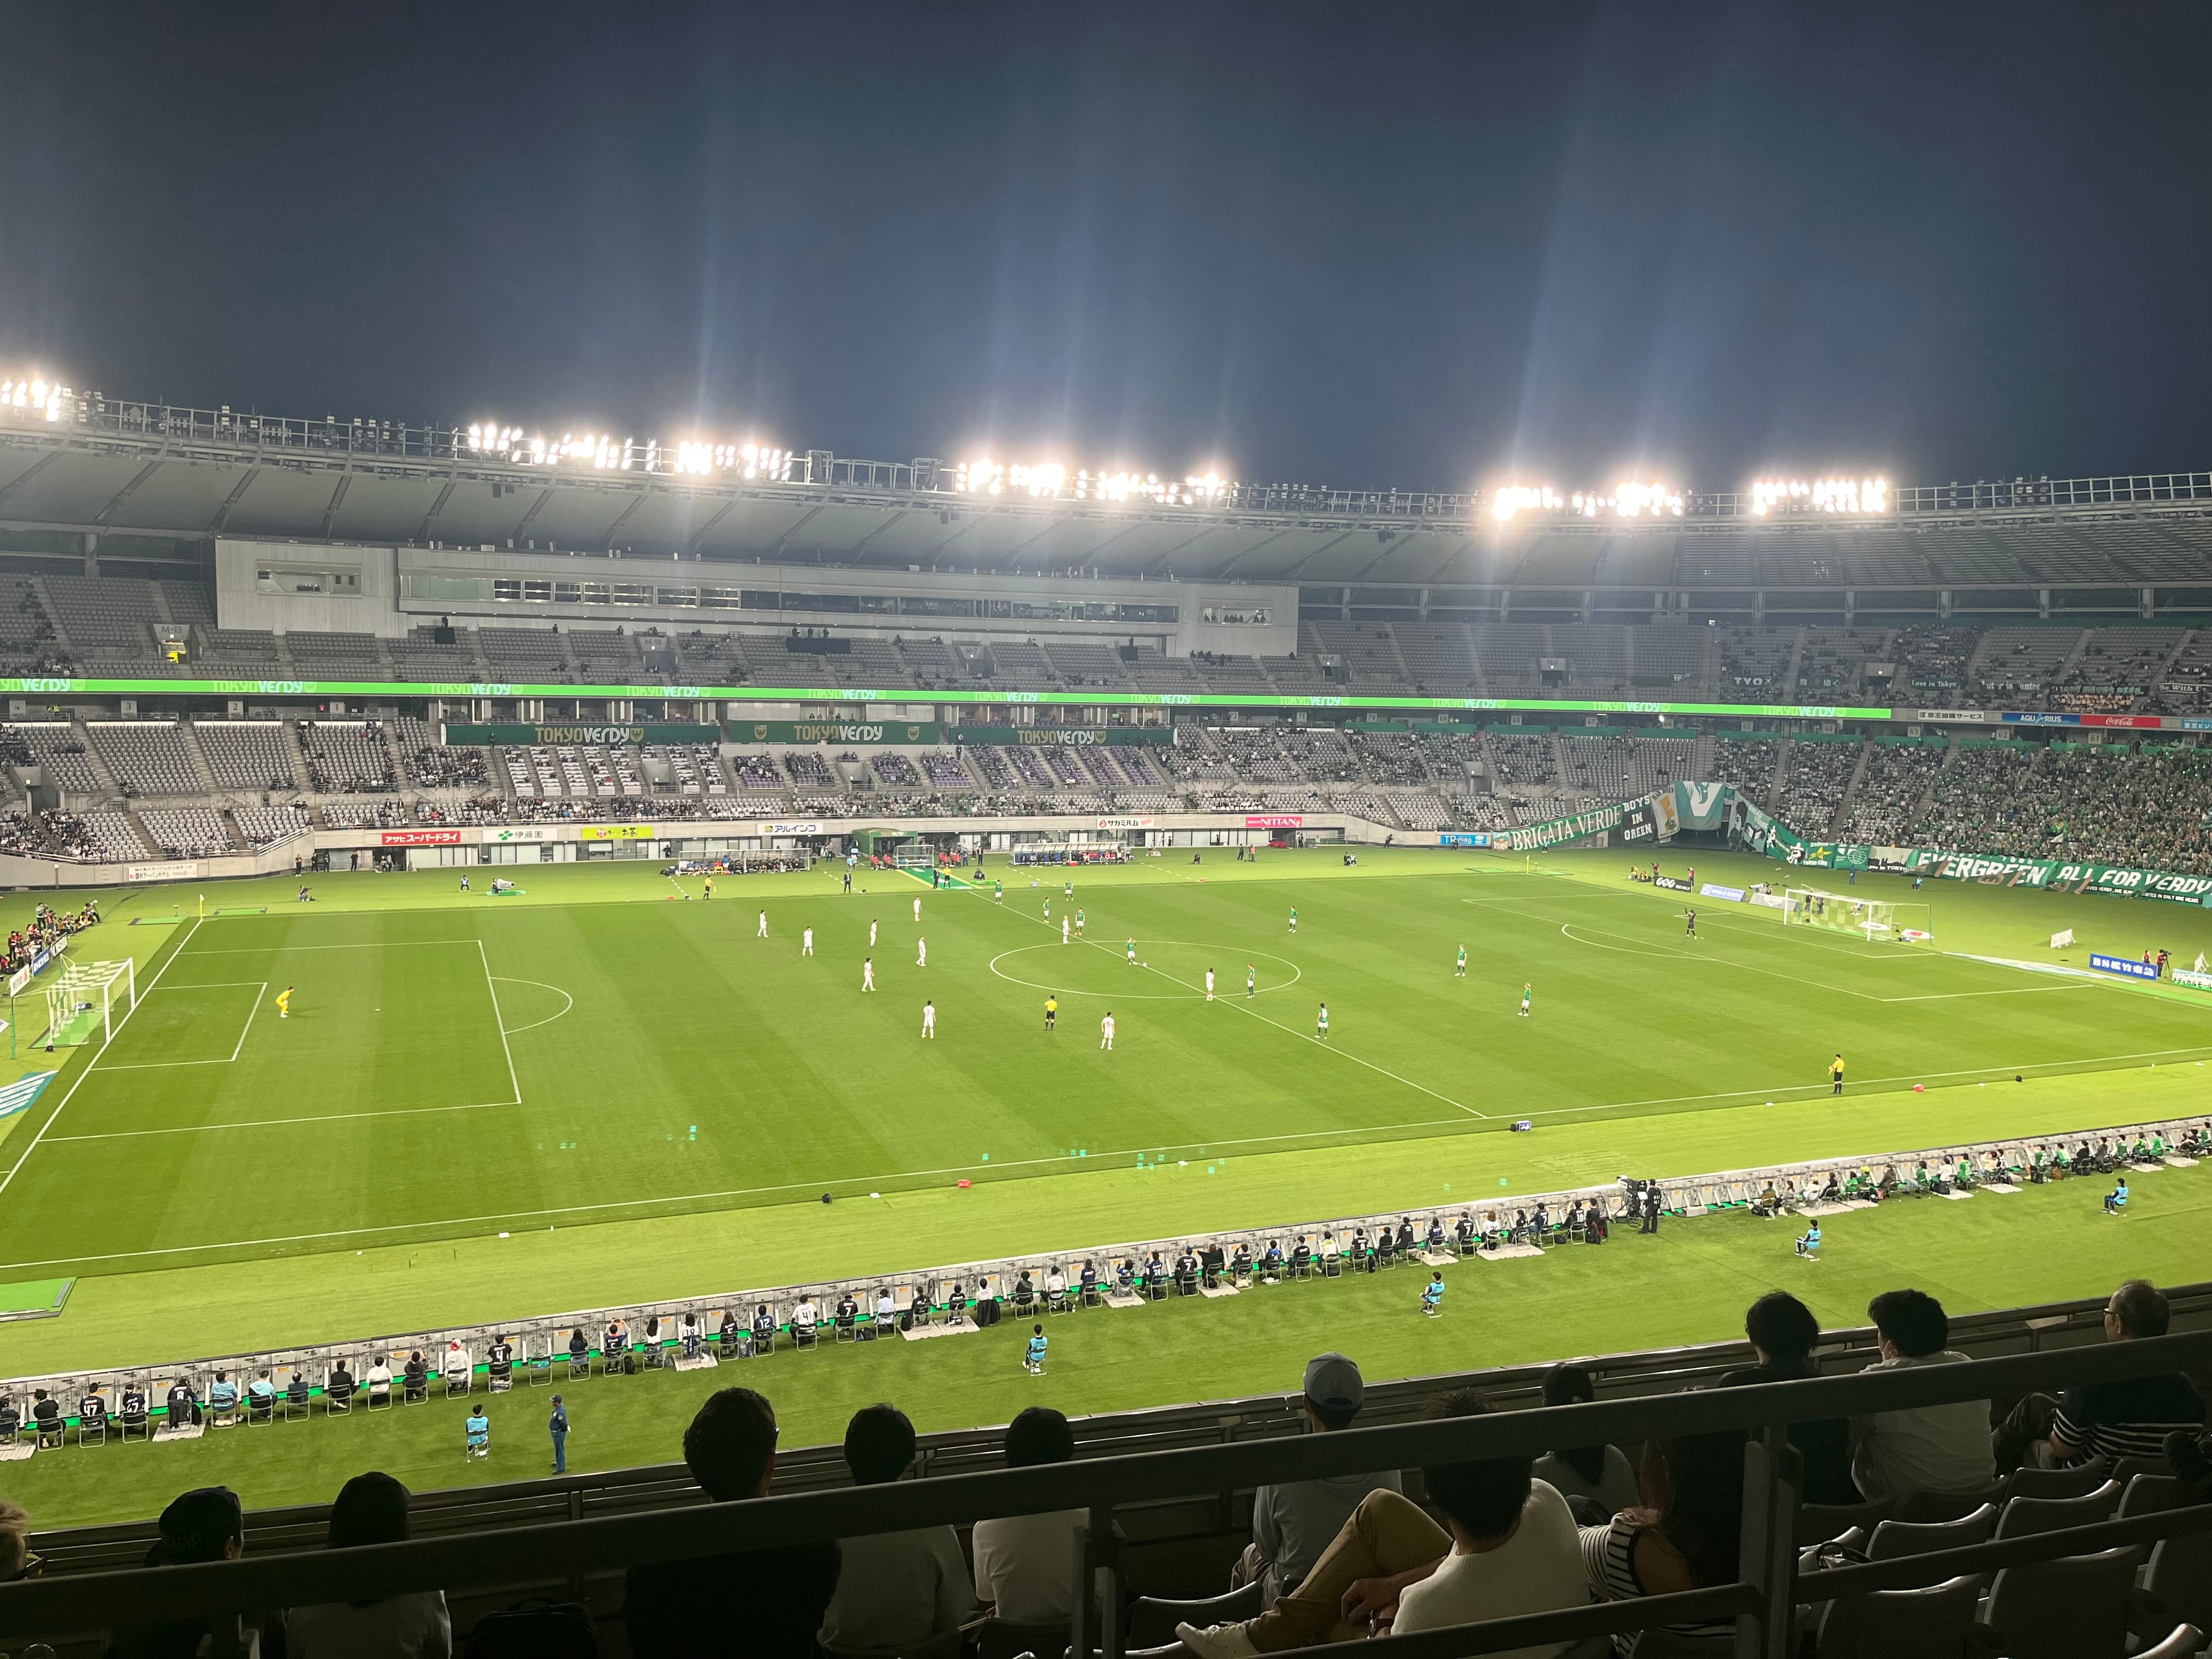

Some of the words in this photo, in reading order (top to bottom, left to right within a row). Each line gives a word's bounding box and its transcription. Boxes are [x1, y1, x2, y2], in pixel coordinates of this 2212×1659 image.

[161, 625, 181, 634] M-13
[126, 702, 131, 710] 3
[1622, 794, 1651, 813] BOYS
[1260, 817, 1296, 825] NITTAN
[1631, 811, 1643, 825] IN
[774, 825, 816, 833] アルインコ
[1510, 819, 1575, 851] BRIGATA
[1575, 805, 1622, 835] VERDE
[1623, 823, 1653, 841] GREEN
[514, 831, 543, 839] 伊藤園
[2098, 870, 2142, 887] FOR
[2145, 873, 2212, 896] VERDY
[759, 1319, 770, 1328] 12
[496, 1350, 503, 1362] 4
[84, 1404, 97, 1416] 47
